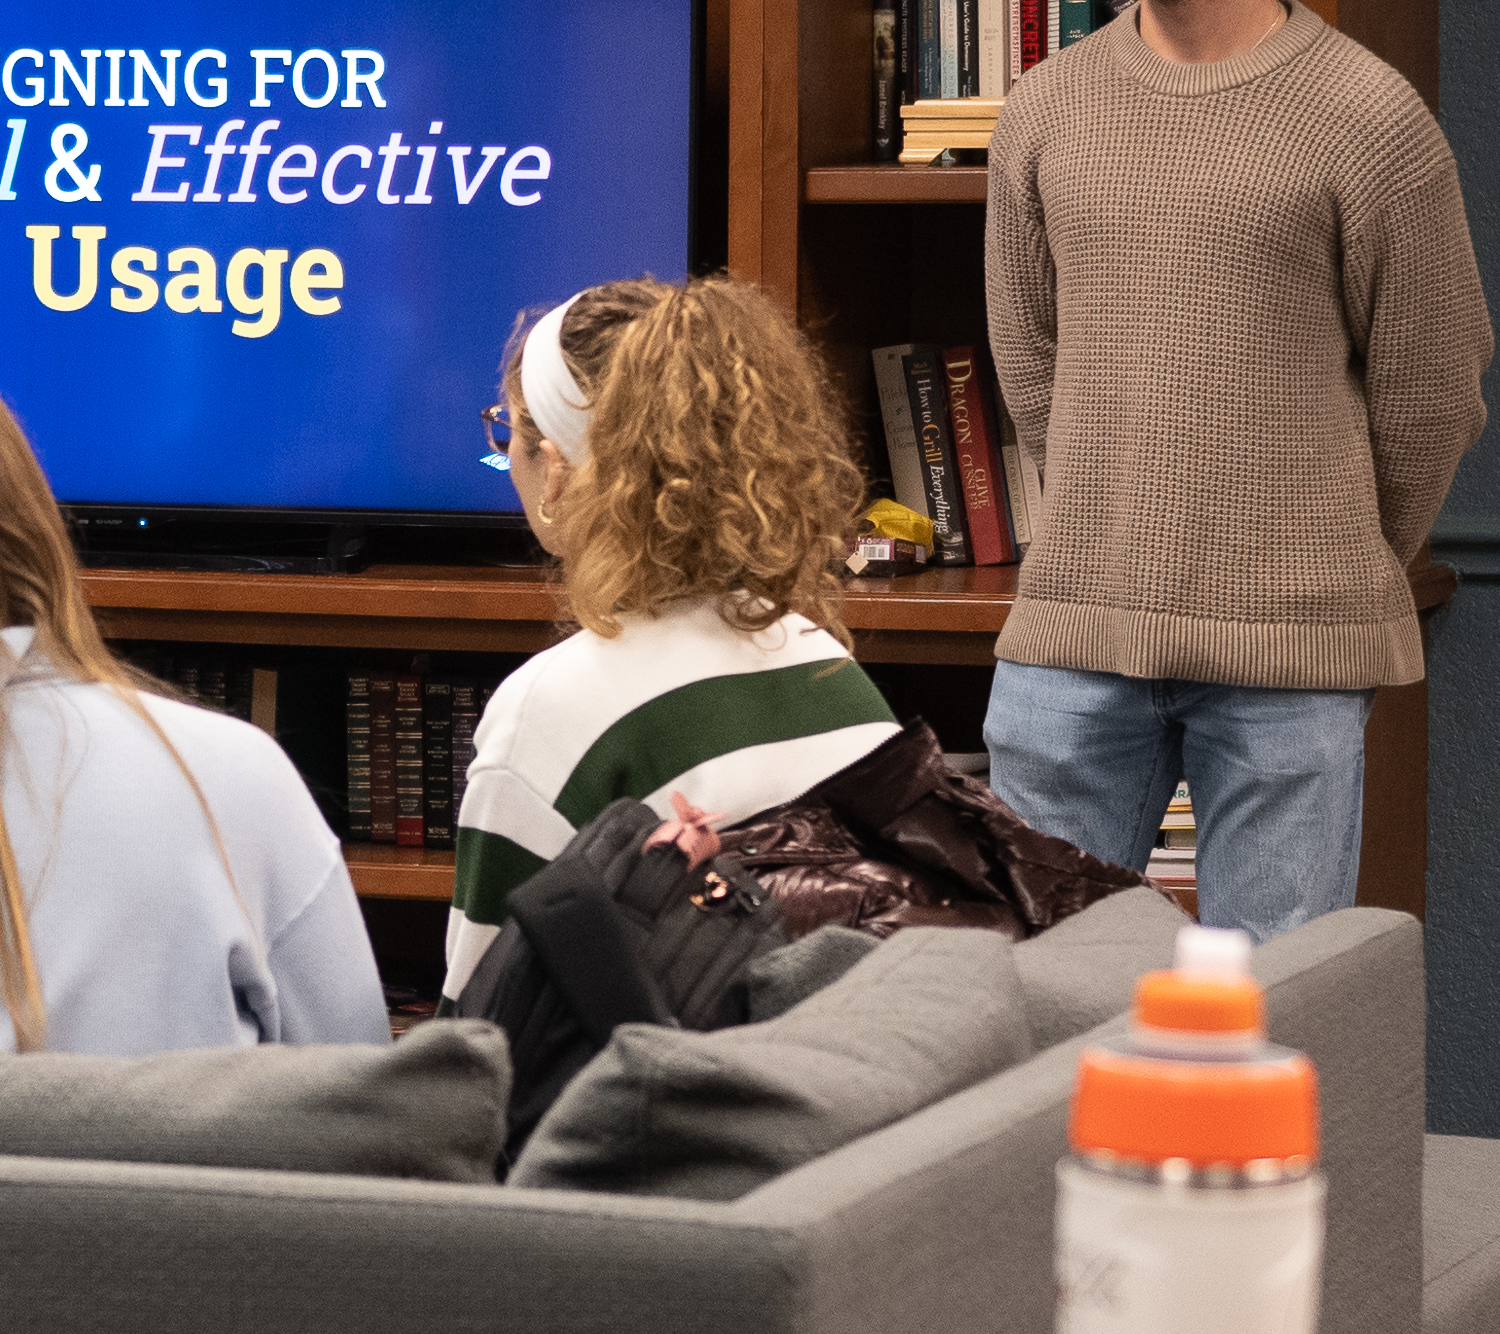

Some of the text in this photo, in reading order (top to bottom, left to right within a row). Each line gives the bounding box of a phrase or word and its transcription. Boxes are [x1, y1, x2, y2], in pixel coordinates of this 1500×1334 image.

[249, 48, 388, 109] FOR
[44, 122, 104, 203] &
[130, 118, 553, 208] Effective
[25, 224, 345, 339] Usage
[946, 358, 973, 444] DRAGON
[916, 378, 951, 535] How to Grill Everything
[973, 468, 991, 509] CLIVE
